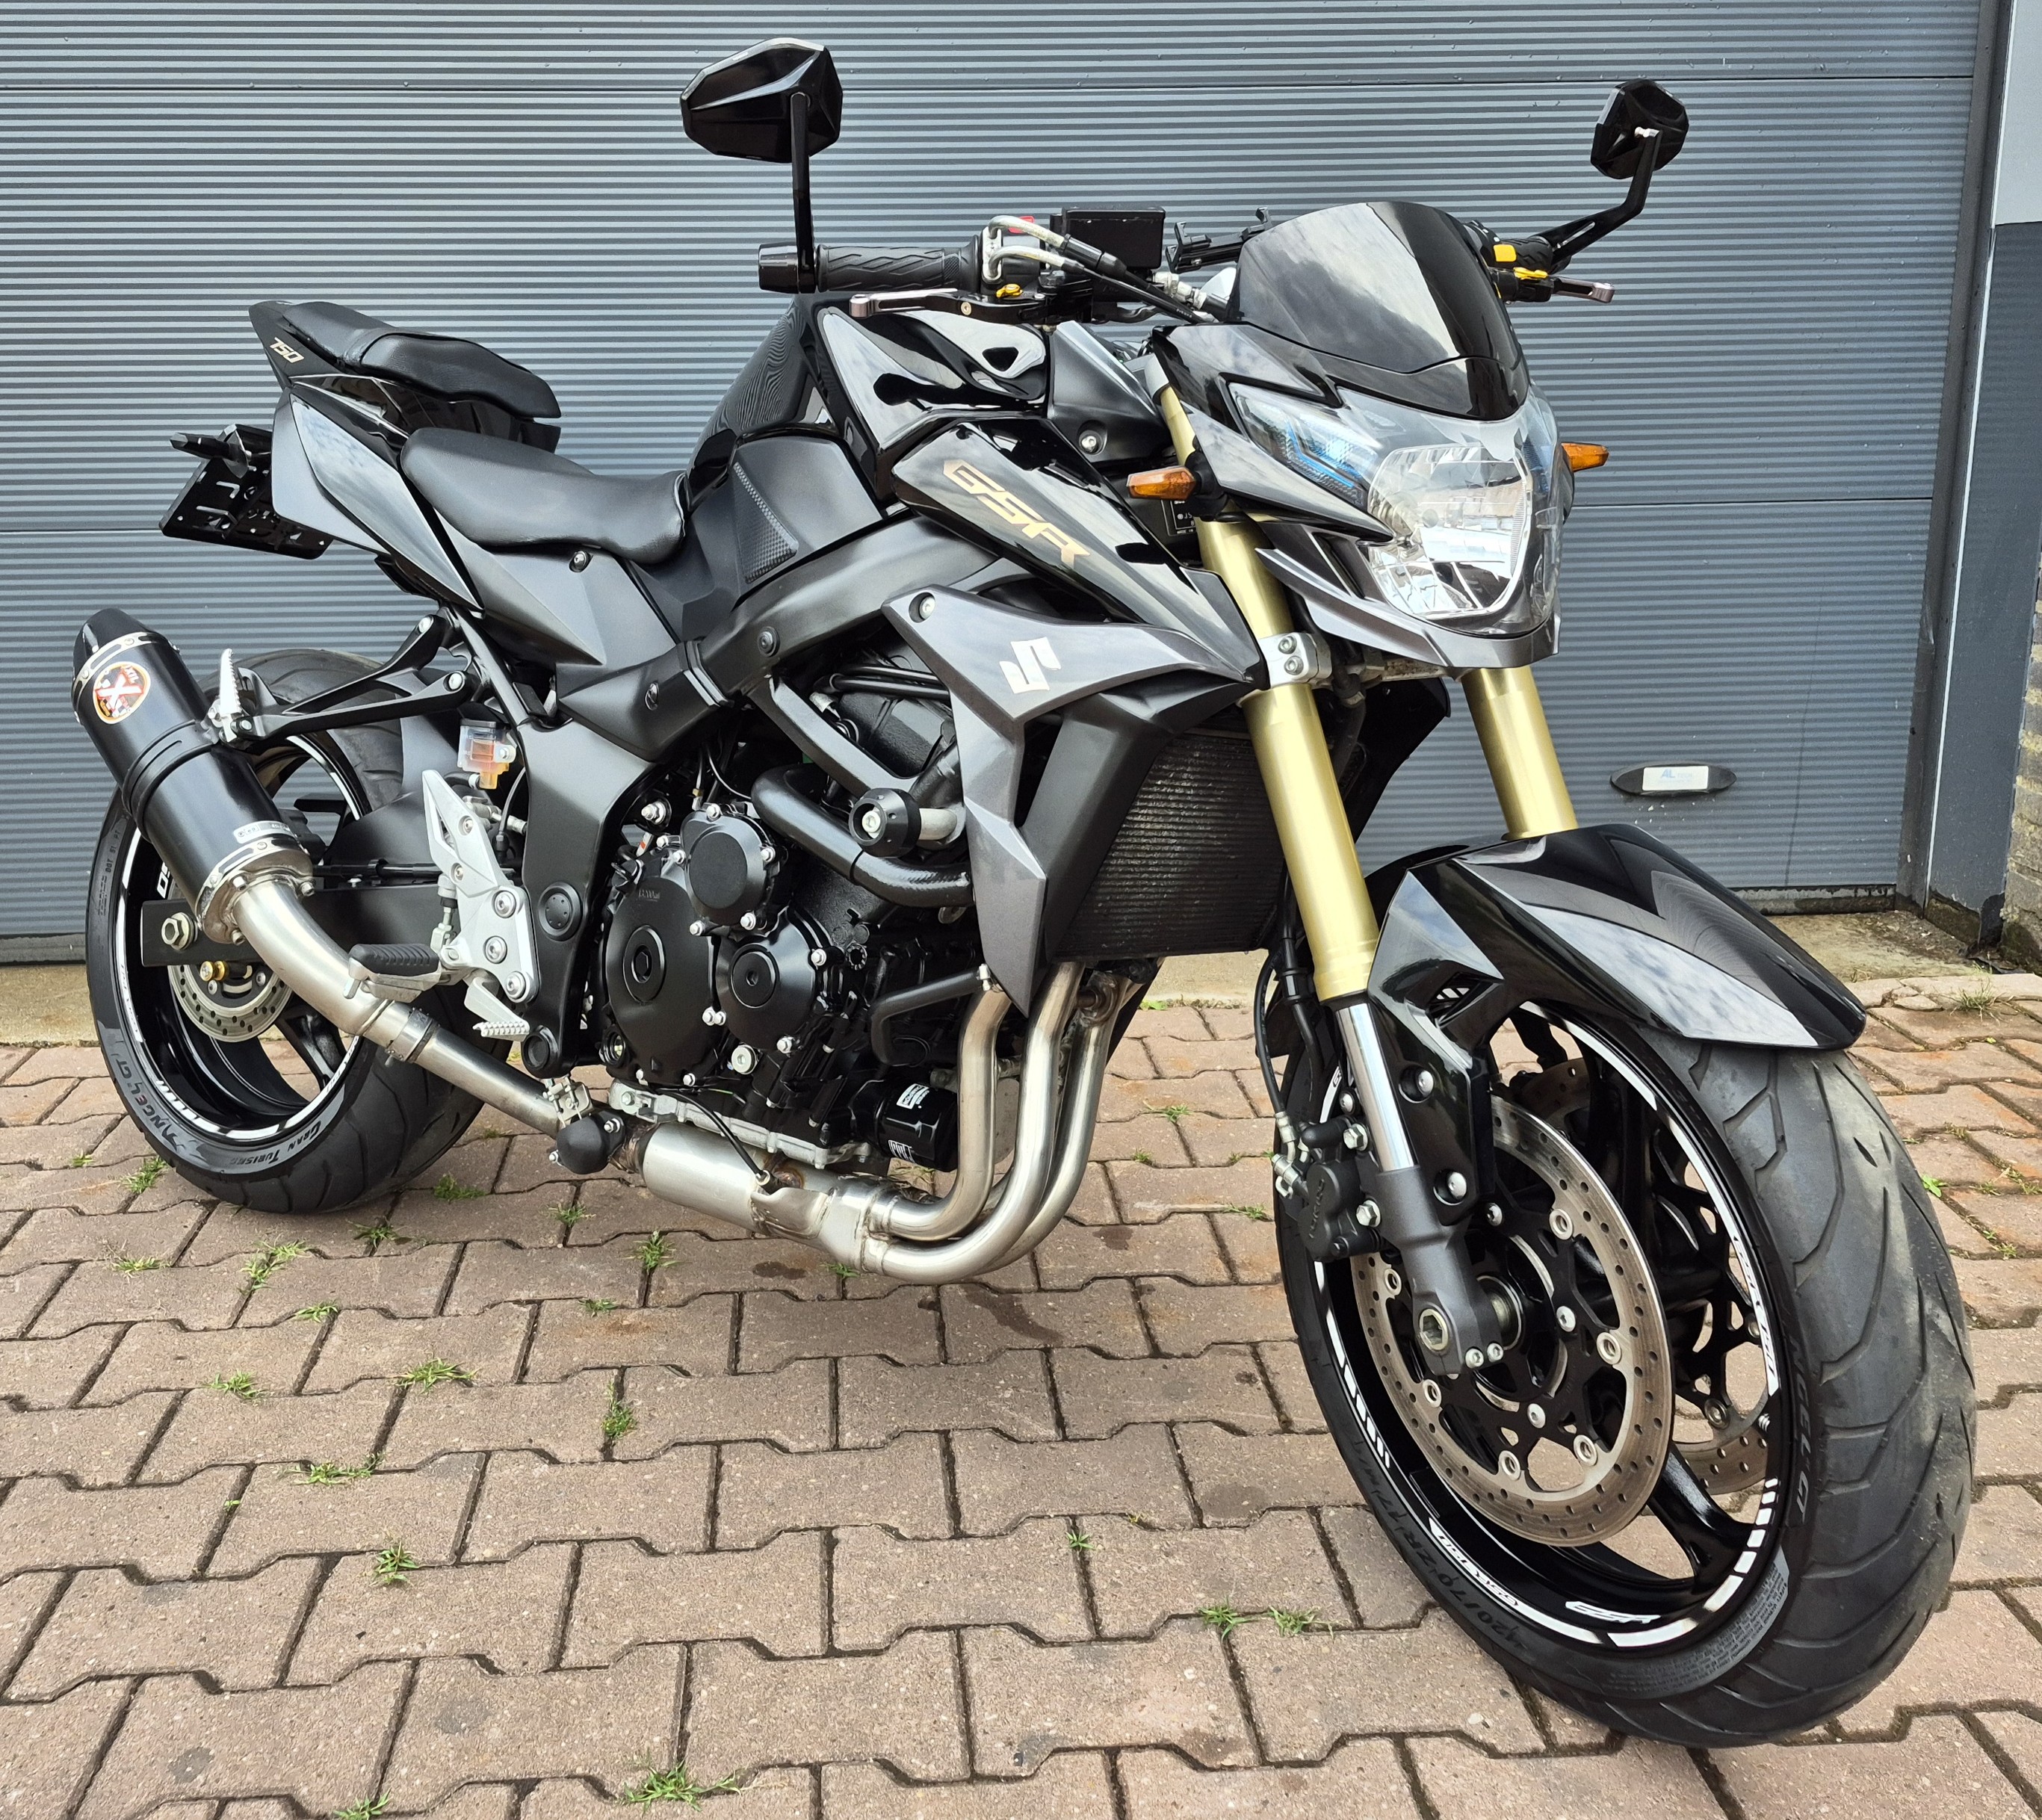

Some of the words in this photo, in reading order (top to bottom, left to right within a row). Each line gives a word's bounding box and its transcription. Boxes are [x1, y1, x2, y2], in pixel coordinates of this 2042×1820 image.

[270, 336, 305, 363] 750
[943, 459, 1091, 569] GSR
[105, 858, 114, 873] DOT
